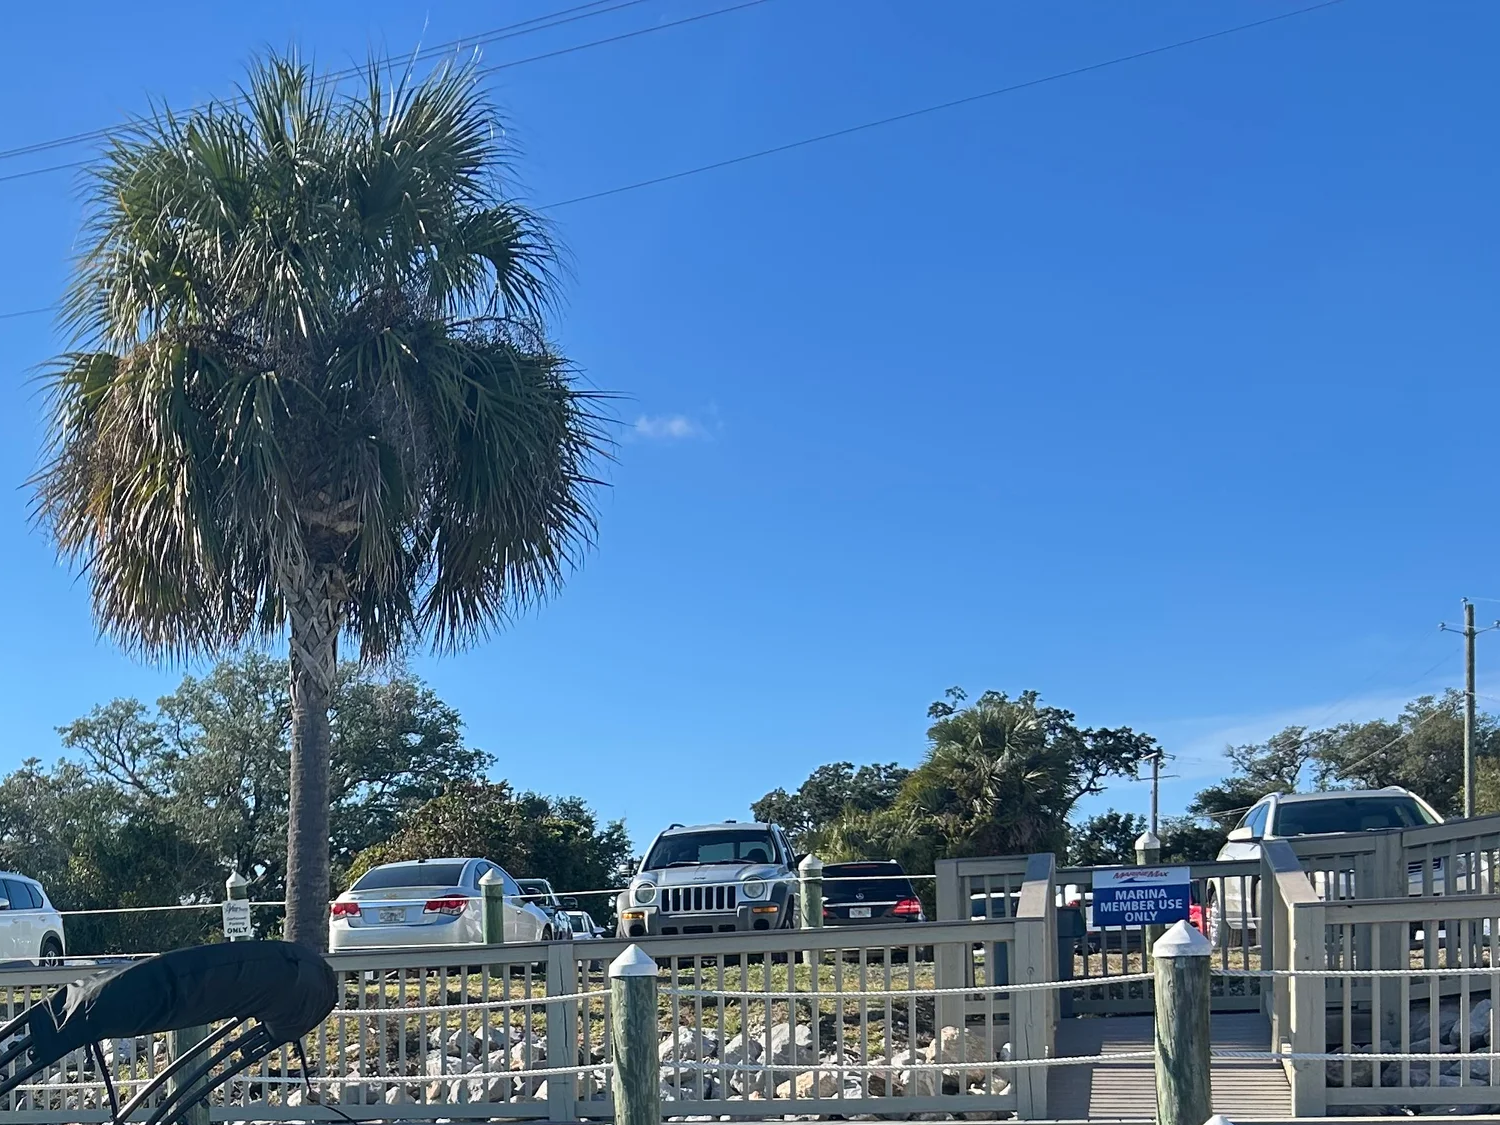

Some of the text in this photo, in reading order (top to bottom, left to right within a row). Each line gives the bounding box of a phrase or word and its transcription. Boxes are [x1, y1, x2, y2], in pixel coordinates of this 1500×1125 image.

[1115, 888, 1168, 900] MARINA
[1100, 899, 1183, 912] MEMBER USE
[1124, 911, 1158, 922] ONLY
[226, 926, 248, 934] ONLY
